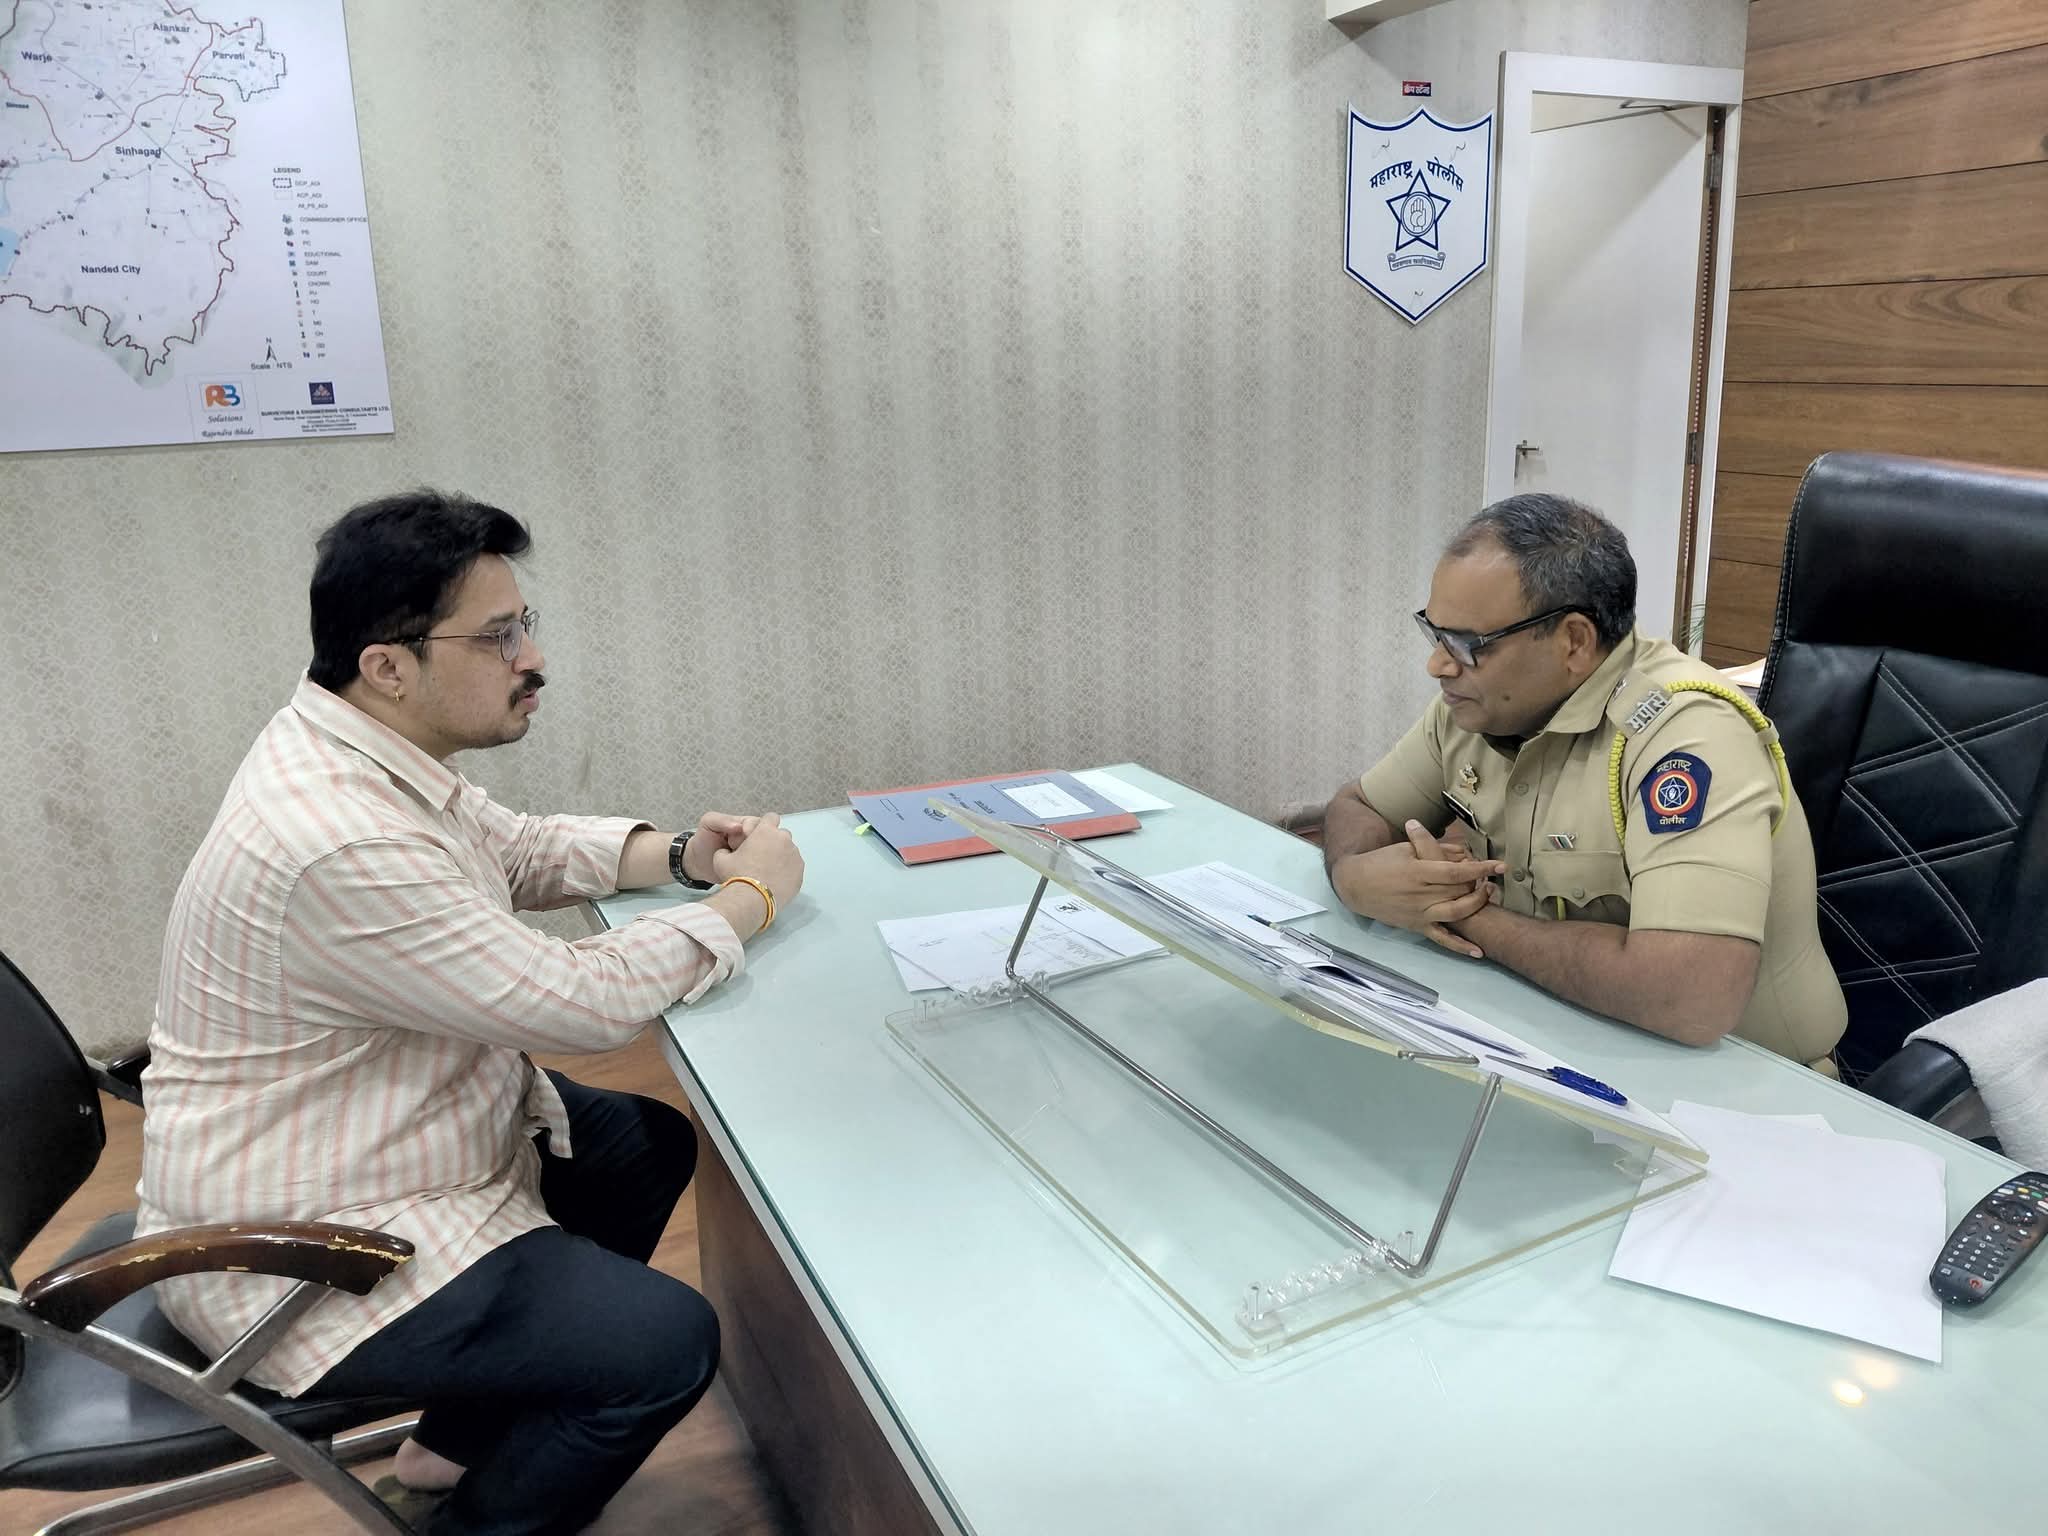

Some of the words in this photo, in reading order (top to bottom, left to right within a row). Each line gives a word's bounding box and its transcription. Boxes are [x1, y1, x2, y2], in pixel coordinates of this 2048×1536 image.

[152, 22, 191, 34] Alankar
[21, 51, 53, 63] Warje
[212, 51, 246, 61] Parvati
[115, 146, 162, 158] Sinhagad
[1369, 160, 1413, 189] महाराष्ट्र
[1426, 156, 1464, 192] पोलीस
[81, 264, 119, 274] Nanded
[121, 264, 141, 275] City
[250, 362, 271, 370] Scale
[208, 414, 243, 423] Solutions
[1656, 759, 1692, 773] महाराष्ट्र
[1660, 814, 1687, 826] पोलीस
